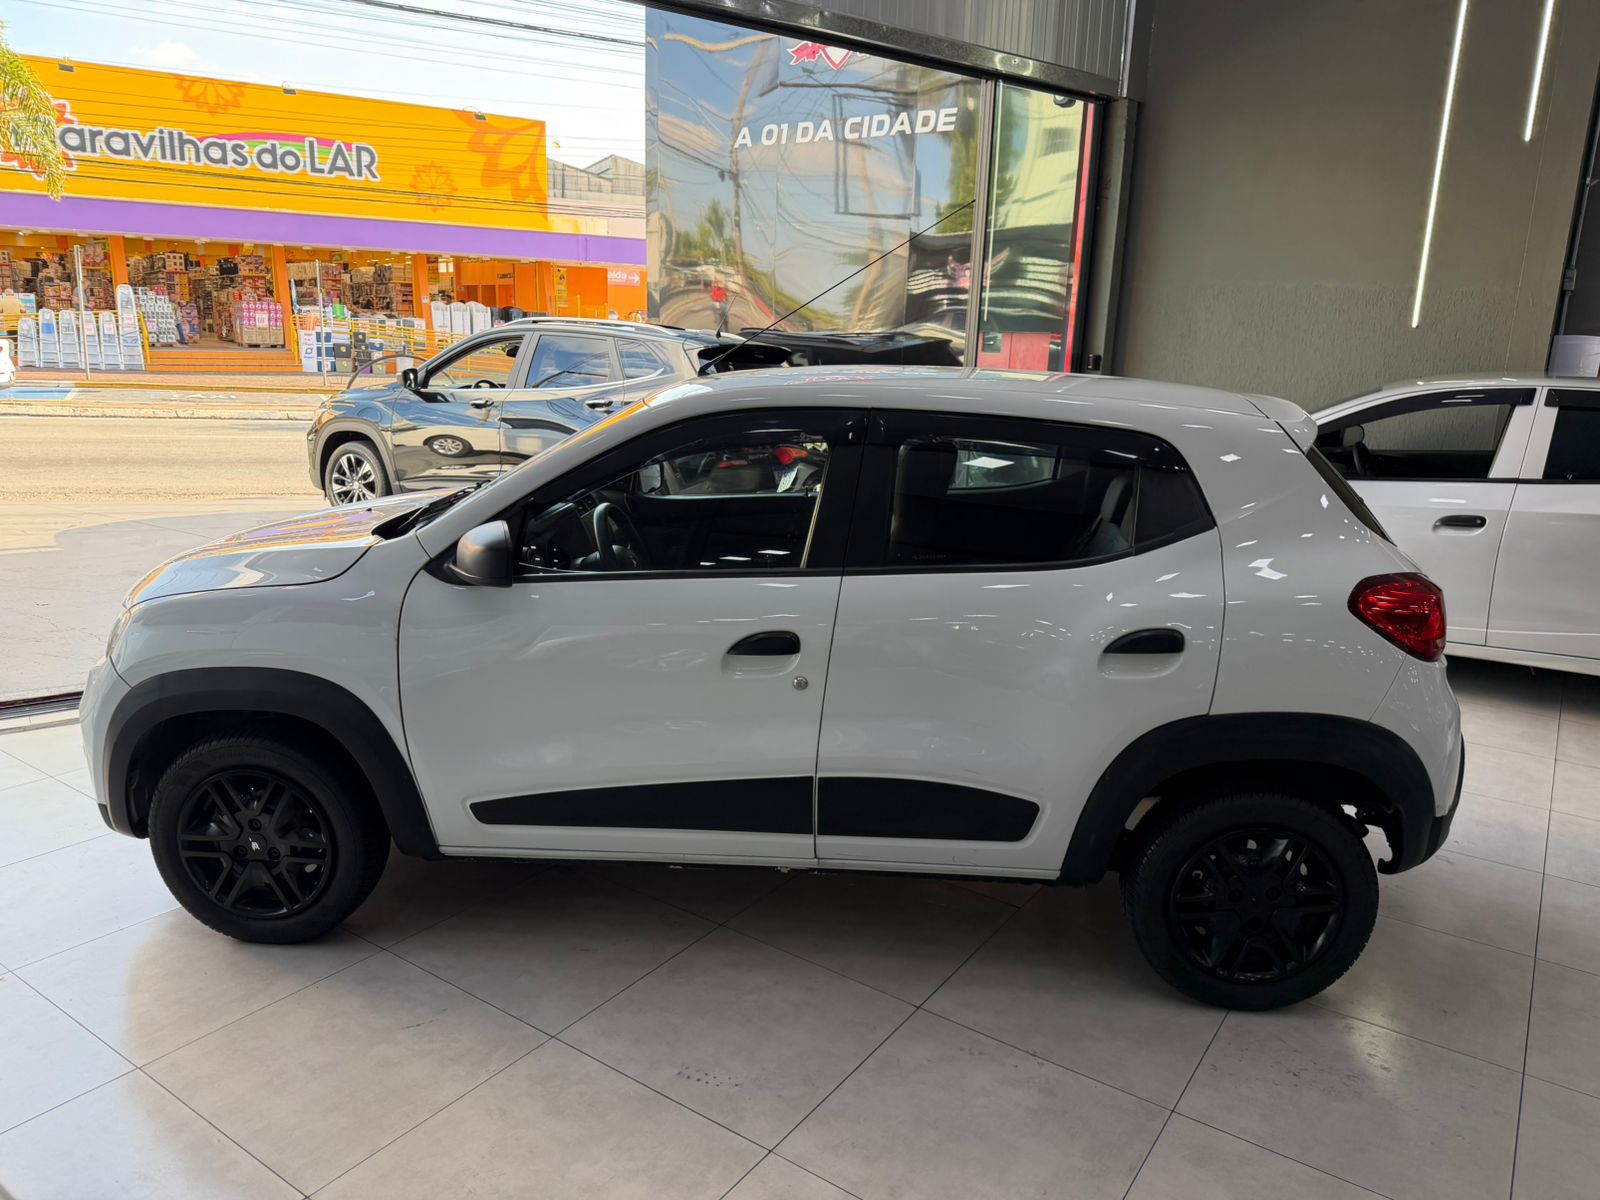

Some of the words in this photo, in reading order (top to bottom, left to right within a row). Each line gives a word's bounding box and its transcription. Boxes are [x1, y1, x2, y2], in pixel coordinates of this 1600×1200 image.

[14, 122, 250, 167] aravilhas
[256, 143, 301, 171] do
[307, 140, 379, 179] LAR
[735, 127, 752, 148] A
[795, 119, 834, 144] DA
[844, 107, 958, 140] CIDADE
